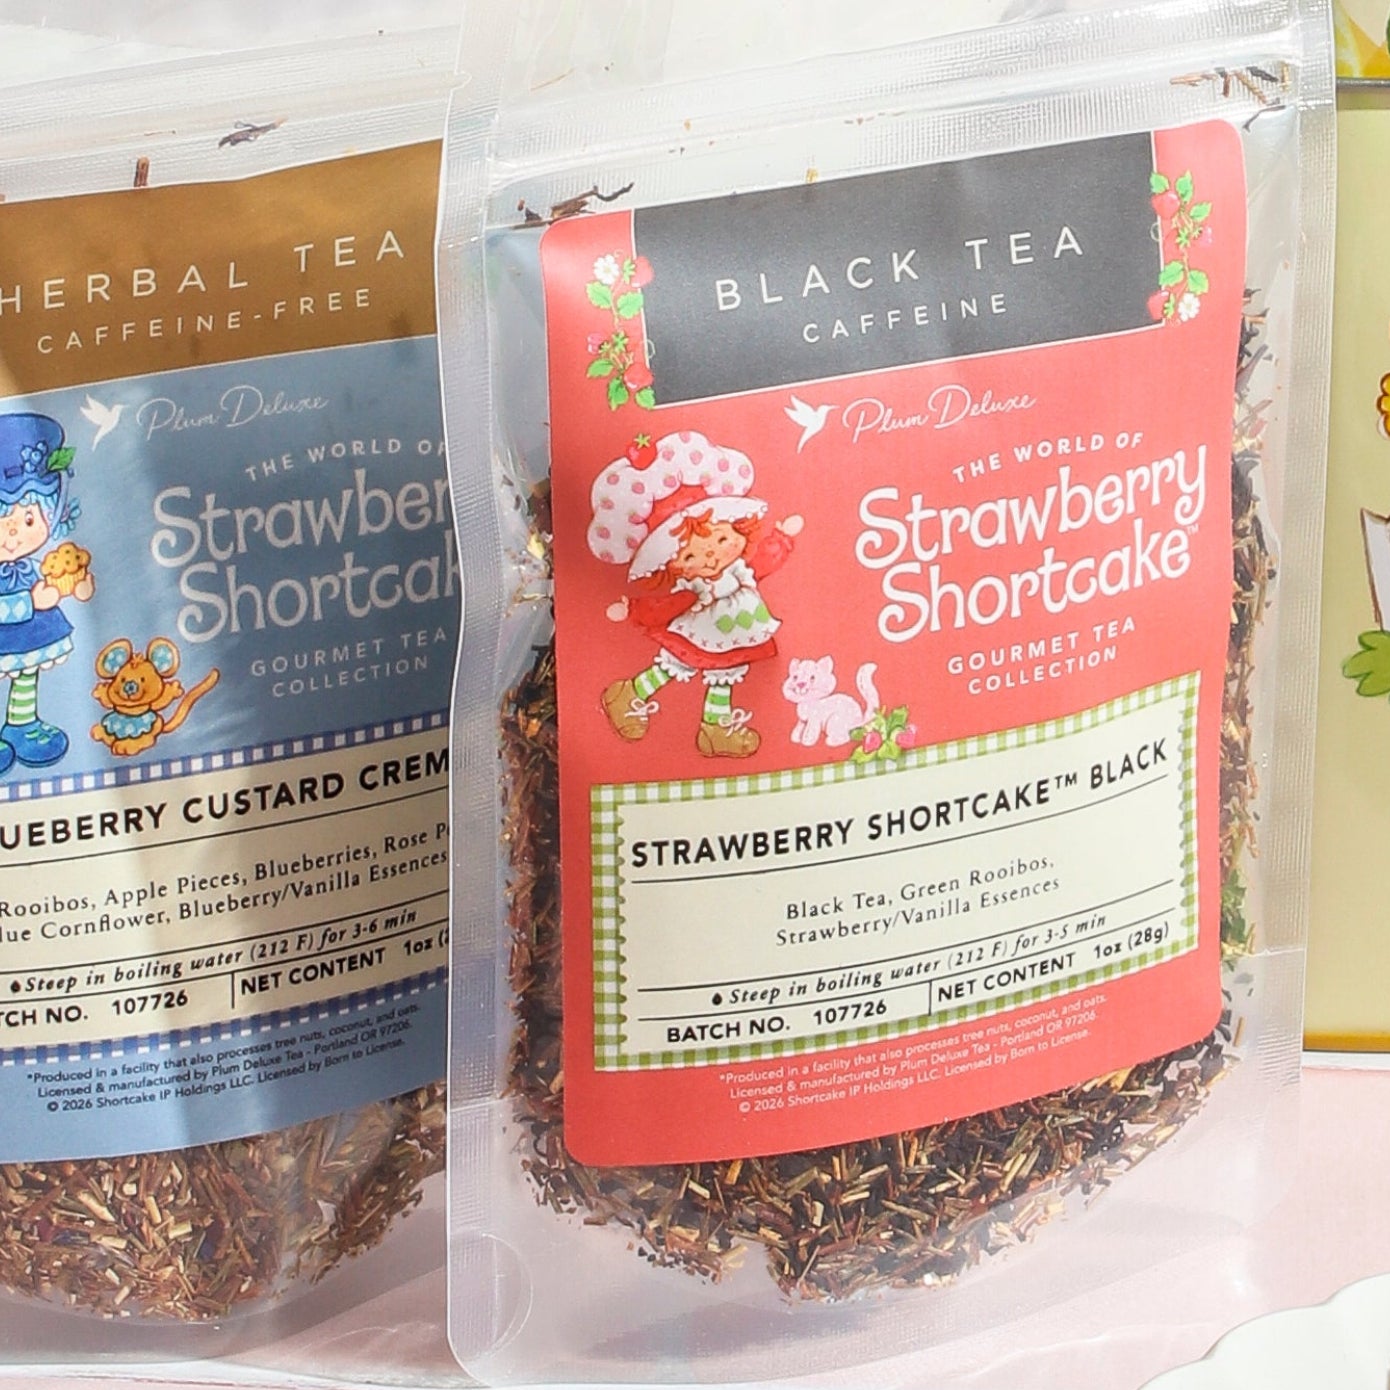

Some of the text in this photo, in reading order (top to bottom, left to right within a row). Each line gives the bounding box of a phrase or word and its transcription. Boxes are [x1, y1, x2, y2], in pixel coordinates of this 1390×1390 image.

[0, 230, 404, 315] HERBAL TEA
[715, 226, 1083, 311] BLACK TEA
[37, 288, 371, 354] CAFFEINE-FREE
[802, 293, 1006, 343] CAFFEINE
[136, 385, 329, 441] Plum Deluxe
[842, 384, 1038, 444] Plum Deluxe
[245, 439, 401, 482] THE WORLD
[952, 432, 1144, 484] THE WORLD OF
[855, 445, 1207, 569] Strawberry
[251, 627, 448, 677] GOURMET TEA
[272, 655, 428, 698] COLLECTION
[947, 616, 1136, 675] GOURMET TEA
[968, 645, 1118, 695] COLLECTION
[0, 803, 167, 850] UEBERRY
[183, 773, 344, 824] CUSTARD
[631, 737, 1168, 868] STRAWBERRY SHORTCAKE™ BLACK
[0, 831, 428, 918] Rooibos, Apple Pieces, Blueberries, Rose
[41, 851, 447, 940] Cornflower, Blueberry/Vanilla Essences
[786, 856, 1055, 920] Black Tea, Green Rooibos,
[776, 878, 1060, 946] Strawberry/Vanilla Essences
[25, 908, 416, 994] Steep in boiling water (212 F) for 3-6 min
[241, 936, 432, 995] NET CONTENT 1oz
[729, 913, 1106, 1005] Steep in boiling water (212 F) for 3-5 min
[938, 921, 1169, 1002] NET CONTENT 1oz (28g)
[46, 989, 188, 1025] NO. 107726
[667, 999, 887, 1043] BATCH NO. 107726
[788, 1065, 799, 1077] in
[802, 1065, 810, 1075] a
[813, 1058, 852, 1073] facility
[854, 1053, 876, 1066] that
[880, 1048, 903, 1061] also
[905, 1036, 960, 1058] processes
[962, 1030, 984, 1043] tree
[1061, 1001, 1081, 1016] and
[38, 1082, 92, 1098] Licensed
[96, 1082, 104, 1093] &
[109, 1068, 190, 1092] manufactured
[194, 1067, 209, 1081] by
[212, 1062, 240, 1077] Plum
[243, 1055, 282, 1071] Deluxe
[286, 1049, 304, 1062] Tea
[314, 1037, 358, 1055] Portland
[360, 1029, 377, 1041] OR
[96, 1065, 107, 1077] in
[121, 1061, 160, 1076] facility
[164, 1057, 187, 1070] that
[190, 1052, 214, 1066] also
[216, 1041, 272, 1065] processes
[275, 1038, 296, 1049] tree
[376, 1010, 395, 1024] and
[730, 1083, 783, 1099] Licensed
[786, 1081, 796, 1093] &
[800, 1066, 879, 1090] manufactured
[882, 1064, 897, 1078] by
[900, 1057, 928, 1070] Plum
[931, 1050, 969, 1065] Deluxe
[971, 1042, 991, 1054] Tea
[1000, 1028, 1044, 1048] Portland
[1046, 1019, 1063, 1033] OR
[754, 1098, 784, 1112] 2026
[787, 1089, 846, 1107] Shortcake
[849, 1087, 860, 1097] IP
[864, 1076, 914, 1095] Holdings
[944, 1057, 992, 1077] Licensed
[994, 1051, 1008, 1065] by
[1011, 1045, 1035, 1060] Born
[1038, 1041, 1049, 1052] to
[62, 1098, 92, 1111] 2026
[96, 1091, 156, 1108] Shortcake
[160, 1090, 171, 1100] IP
[175, 1079, 226, 1098] Holdings
[258, 1066, 305, 1083] Licensed
[308, 1061, 322, 1072] by
[325, 1055, 349, 1068] Born
[352, 1050, 363, 1060] to
